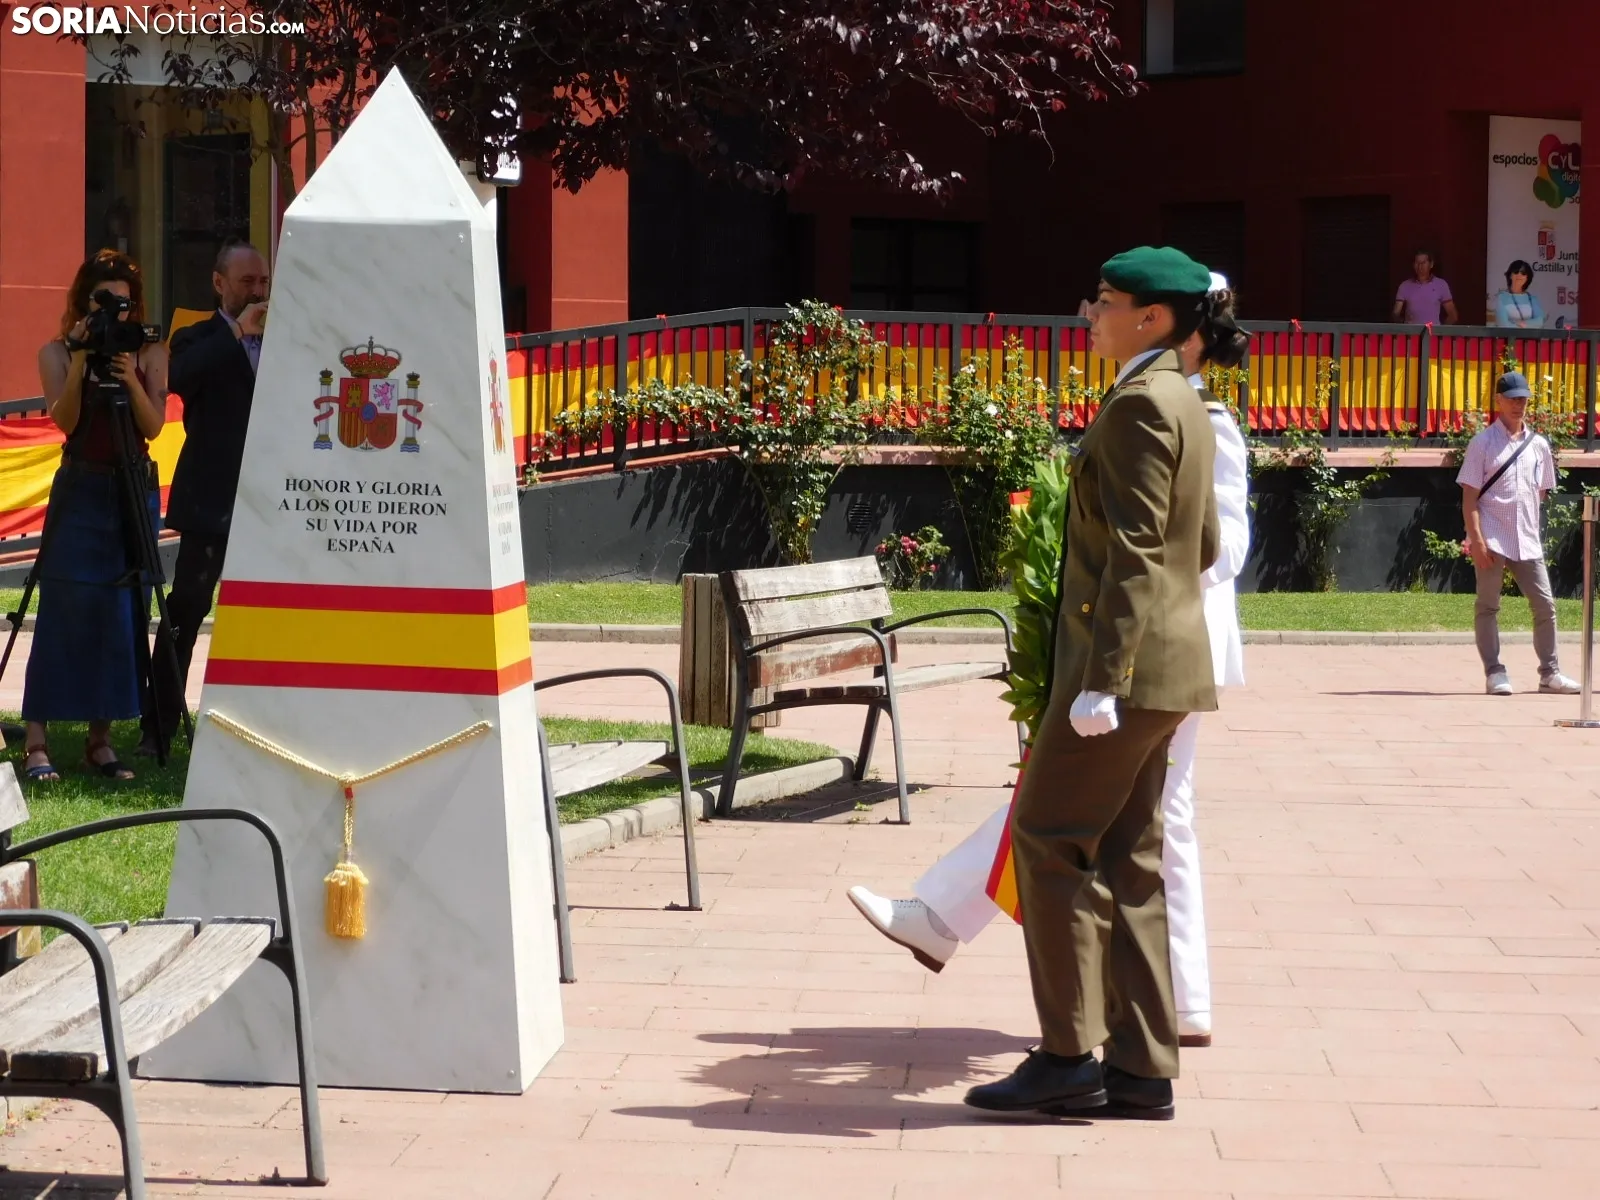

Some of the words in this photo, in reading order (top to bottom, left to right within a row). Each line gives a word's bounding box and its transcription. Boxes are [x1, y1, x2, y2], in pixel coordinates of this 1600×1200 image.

[1492, 152, 1538, 167] espacios
[1532, 261, 1565, 273] Castilla
[1567, 264, 1573, 276] y
[285, 478, 351, 494] HONOR
[356, 480, 368, 494] Y
[371, 481, 443, 497] GLORIA
[278, 498, 290, 511] A
[295, 498, 330, 513] LOS
[334, 499, 372, 515] QUE
[377, 500, 447, 516] DIERON
[305, 518, 328, 532] SU
[333, 519, 377, 534] VIDA
[381, 520, 418, 535] POR
[327, 537, 396, 554] ESPAÑA
